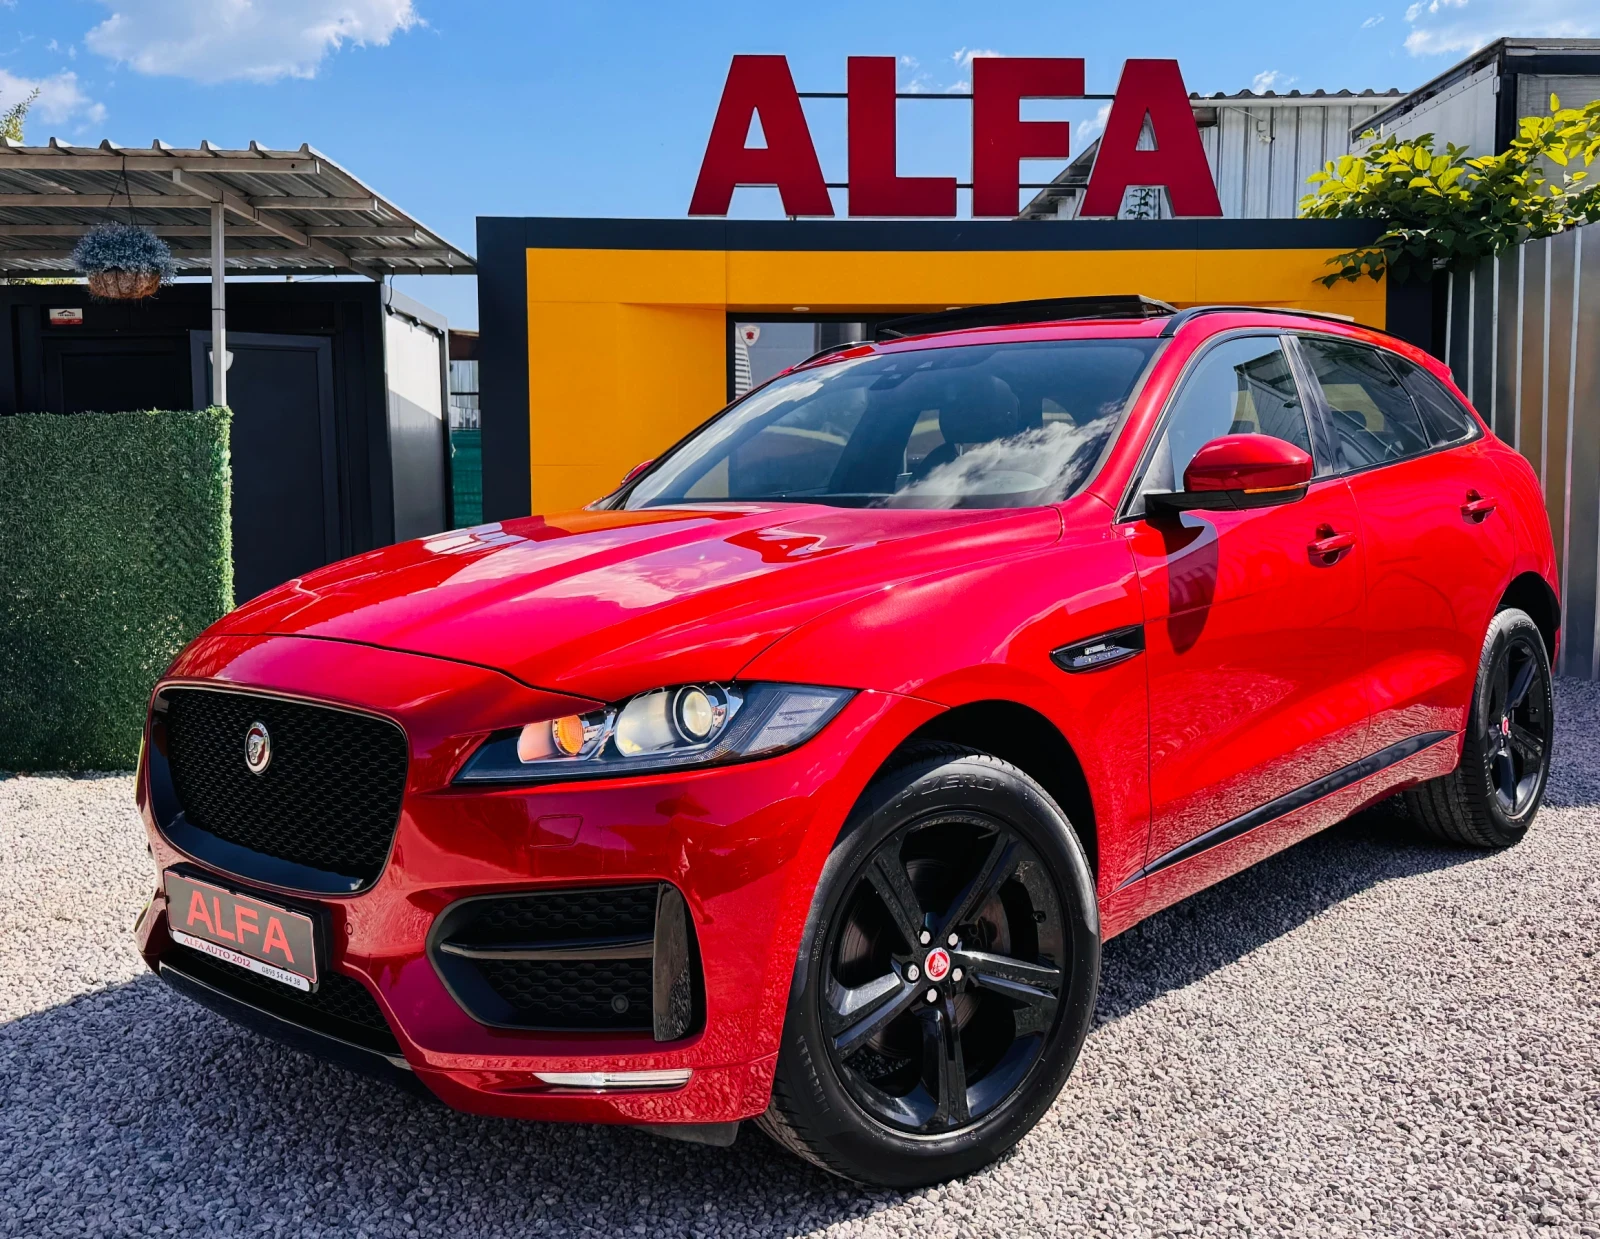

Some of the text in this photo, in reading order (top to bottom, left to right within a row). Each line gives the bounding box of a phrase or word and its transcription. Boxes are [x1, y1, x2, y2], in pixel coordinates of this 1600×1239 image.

[687, 54, 1223, 218] ALFA
[920, 773, 998, 796] ZERO
[183, 937, 251, 968] ALFA AUTO 2012
[186, 890, 295, 964] ALFA
